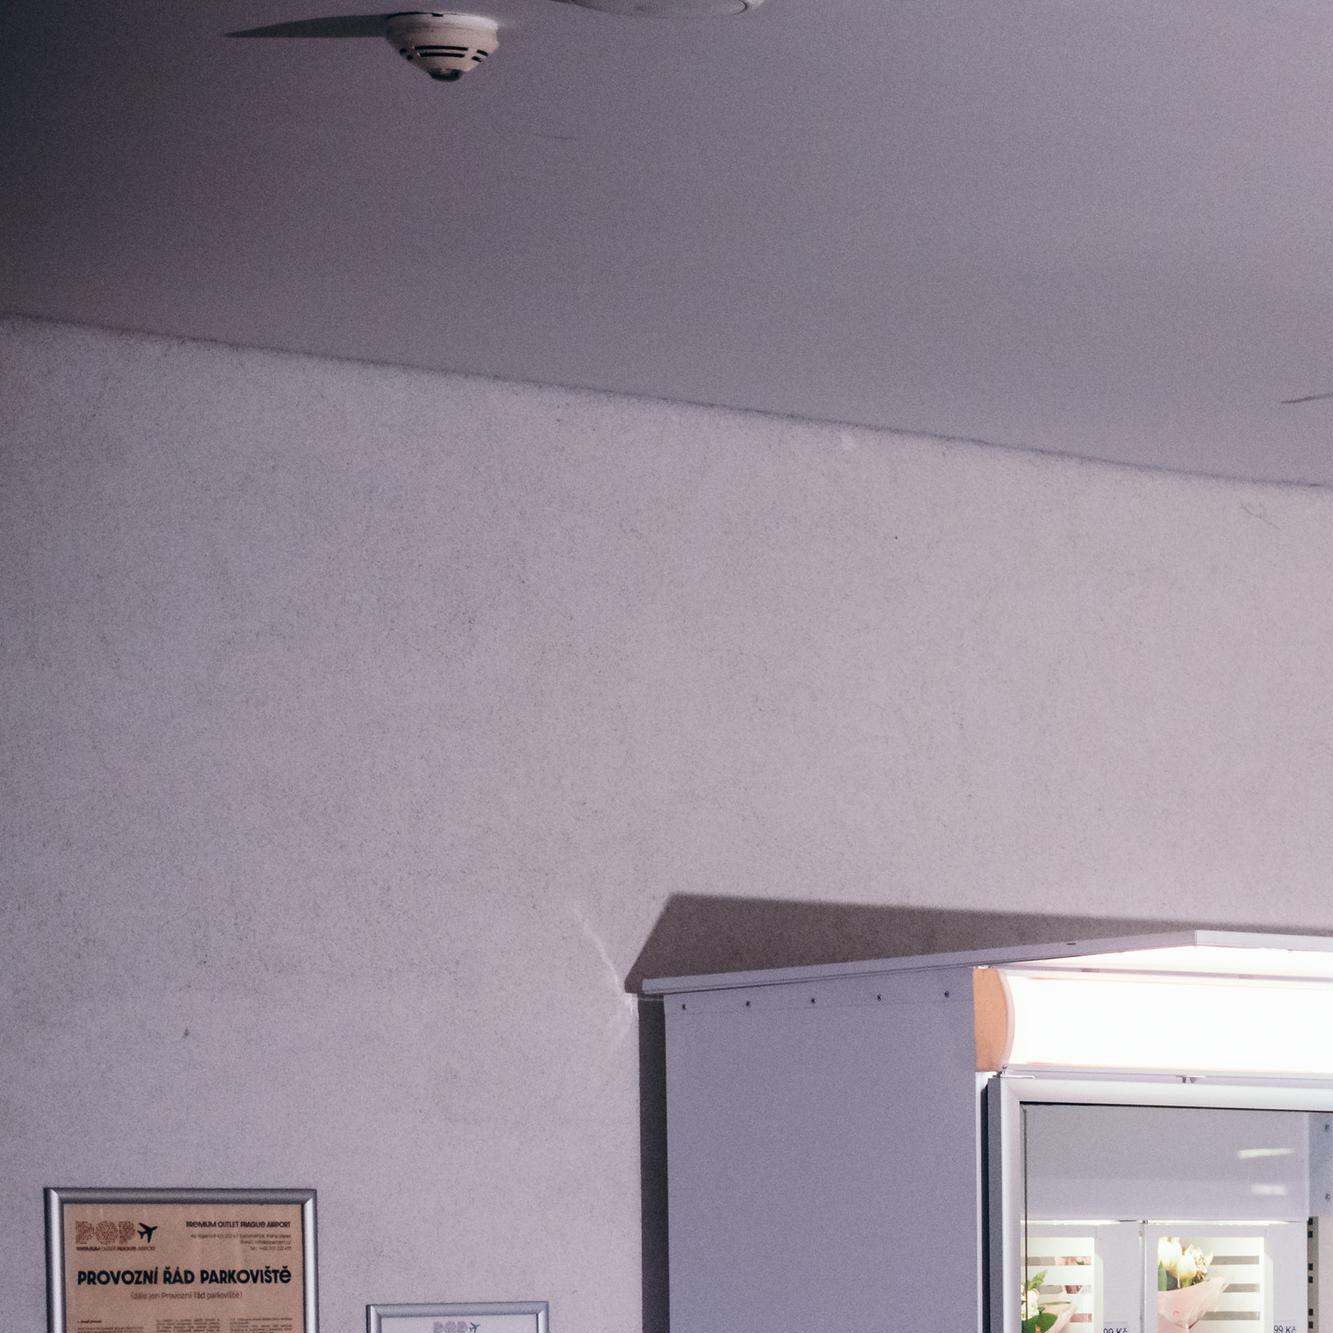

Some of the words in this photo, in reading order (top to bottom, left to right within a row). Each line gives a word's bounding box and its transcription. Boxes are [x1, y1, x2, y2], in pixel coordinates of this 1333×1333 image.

[266, 1221, 292, 1229] AIRPORT
[77, 1266, 159, 1286] PROVOZNÍ
[163, 1266, 195, 1285] ŘÁD
